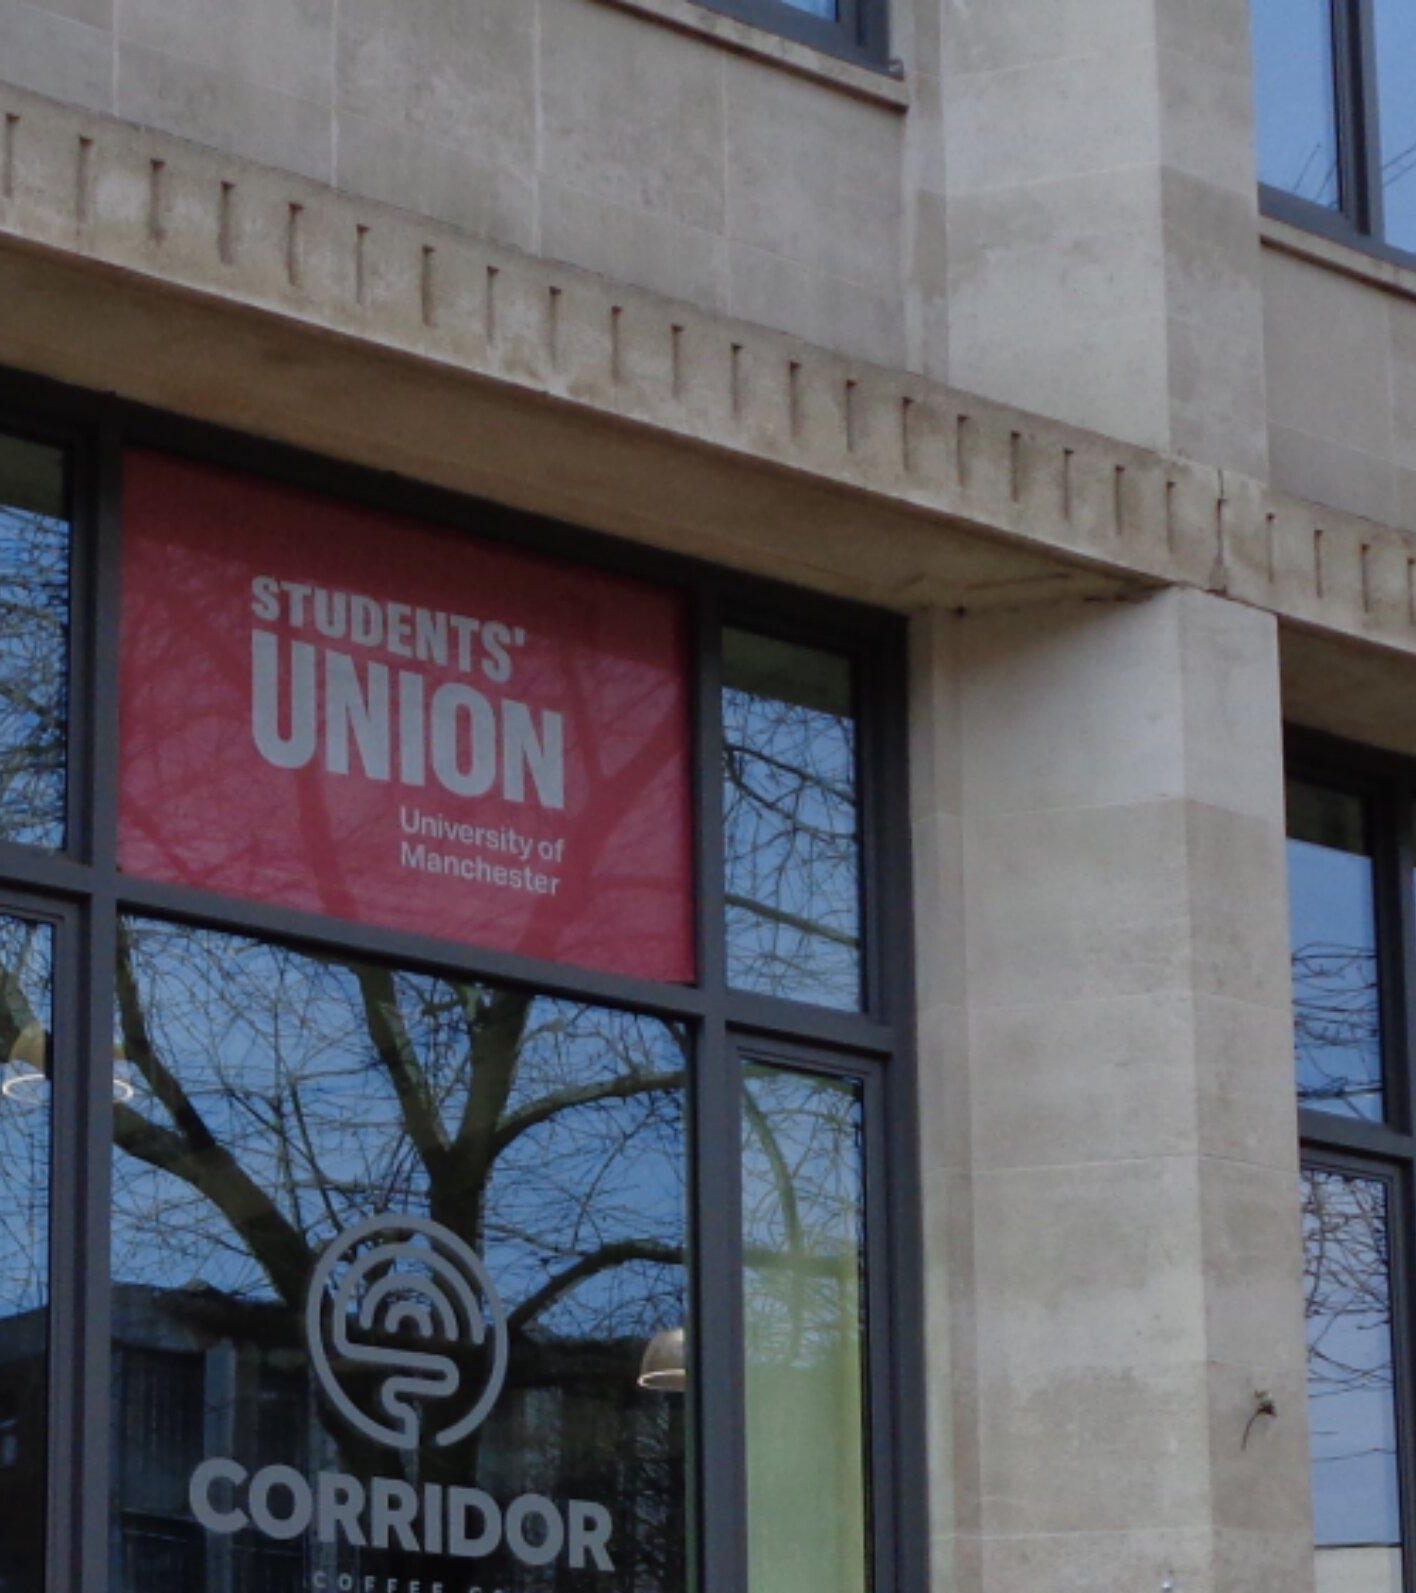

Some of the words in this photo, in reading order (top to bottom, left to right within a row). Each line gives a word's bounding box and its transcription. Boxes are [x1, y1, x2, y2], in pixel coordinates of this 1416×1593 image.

[251, 575, 526, 684] STUDENTS'
[251, 628, 565, 810] UNION
[400, 805, 532, 862] University
[537, 838, 565, 863] of
[400, 840, 561, 897] Manchester
[188, 1457, 615, 1572] CORRIDOR
